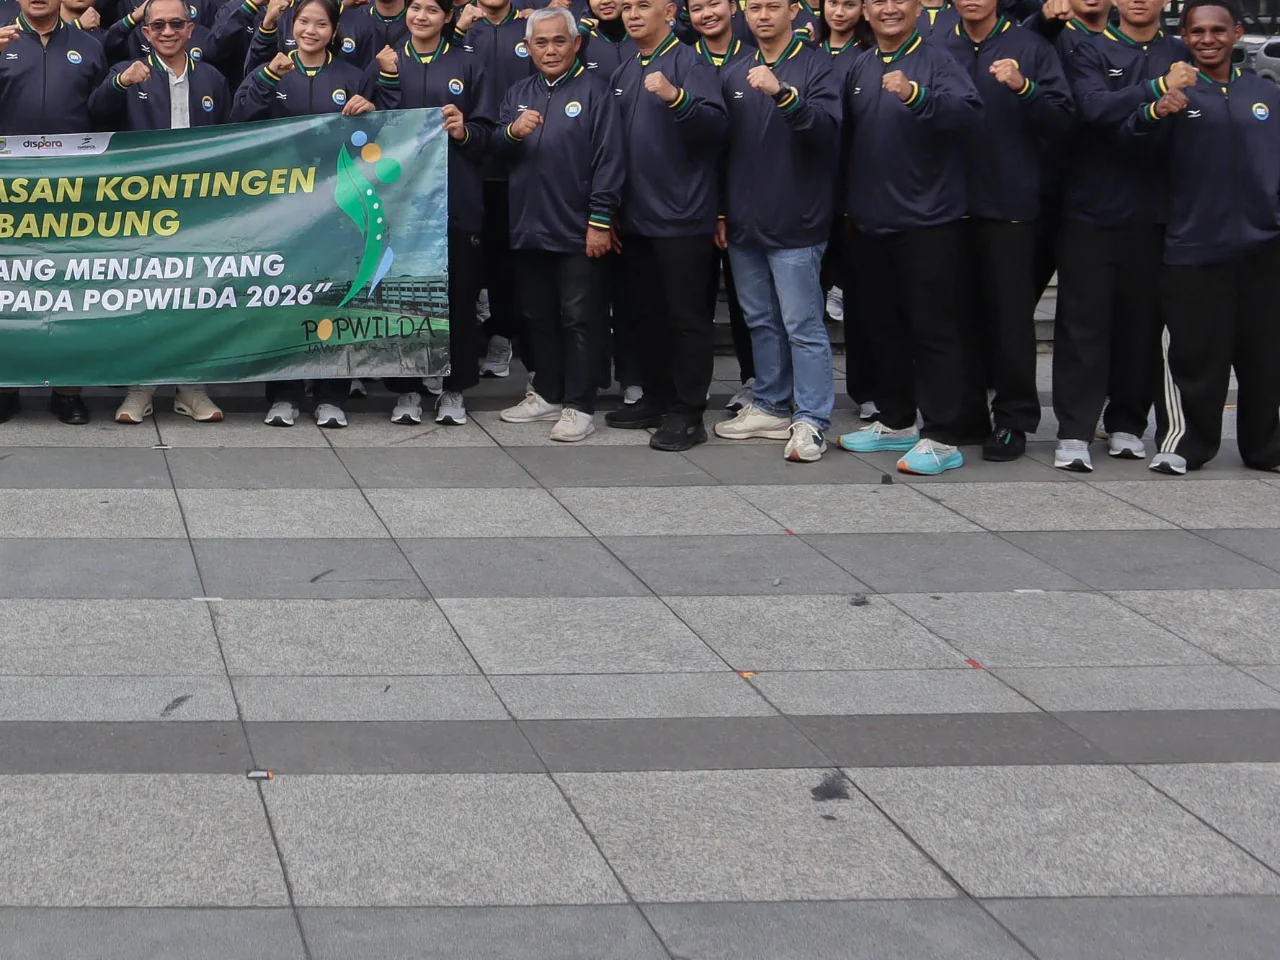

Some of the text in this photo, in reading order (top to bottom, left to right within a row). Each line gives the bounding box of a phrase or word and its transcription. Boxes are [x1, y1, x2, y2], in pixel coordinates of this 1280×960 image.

[23, 137, 62, 149] dispora
[96, 167, 316, 202] KONTINGEN
[64, 256, 194, 280] MENJADI
[202, 254, 285, 278] YANG
[83, 286, 237, 311] POPWILDA
[301, 315, 437, 341] POPWILDA
